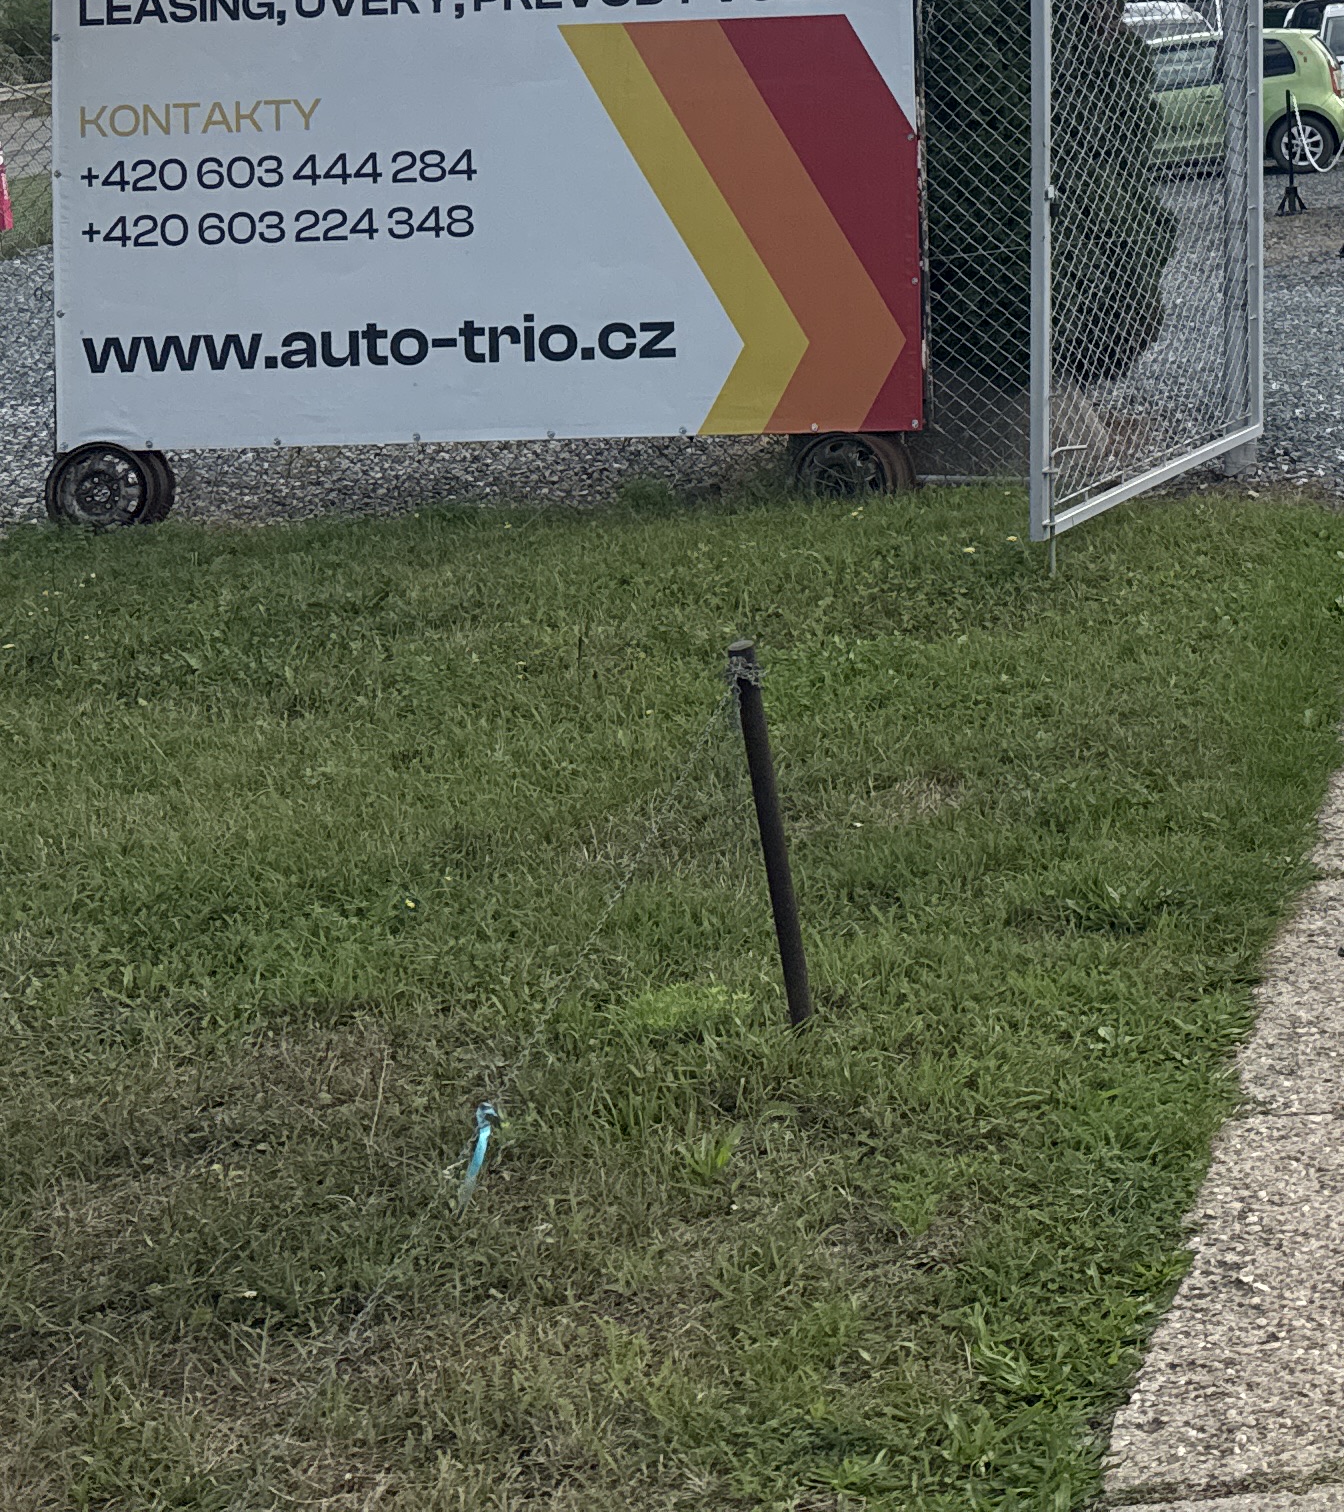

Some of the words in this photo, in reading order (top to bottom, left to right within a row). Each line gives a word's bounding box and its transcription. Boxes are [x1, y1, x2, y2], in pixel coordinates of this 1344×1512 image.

[80, 97, 322, 138] KONTAKTY
[81, 158, 187, 192] +420
[197, 155, 284, 189] 603
[293, 152, 382, 186] 444
[391, 149, 477, 183] 284
[82, 214, 188, 248] +420
[198, 211, 286, 245] 603
[294, 208, 379, 242] 224
[387, 205, 475, 239] 348
[82, 313, 677, 374] www.auto-trio.cz
